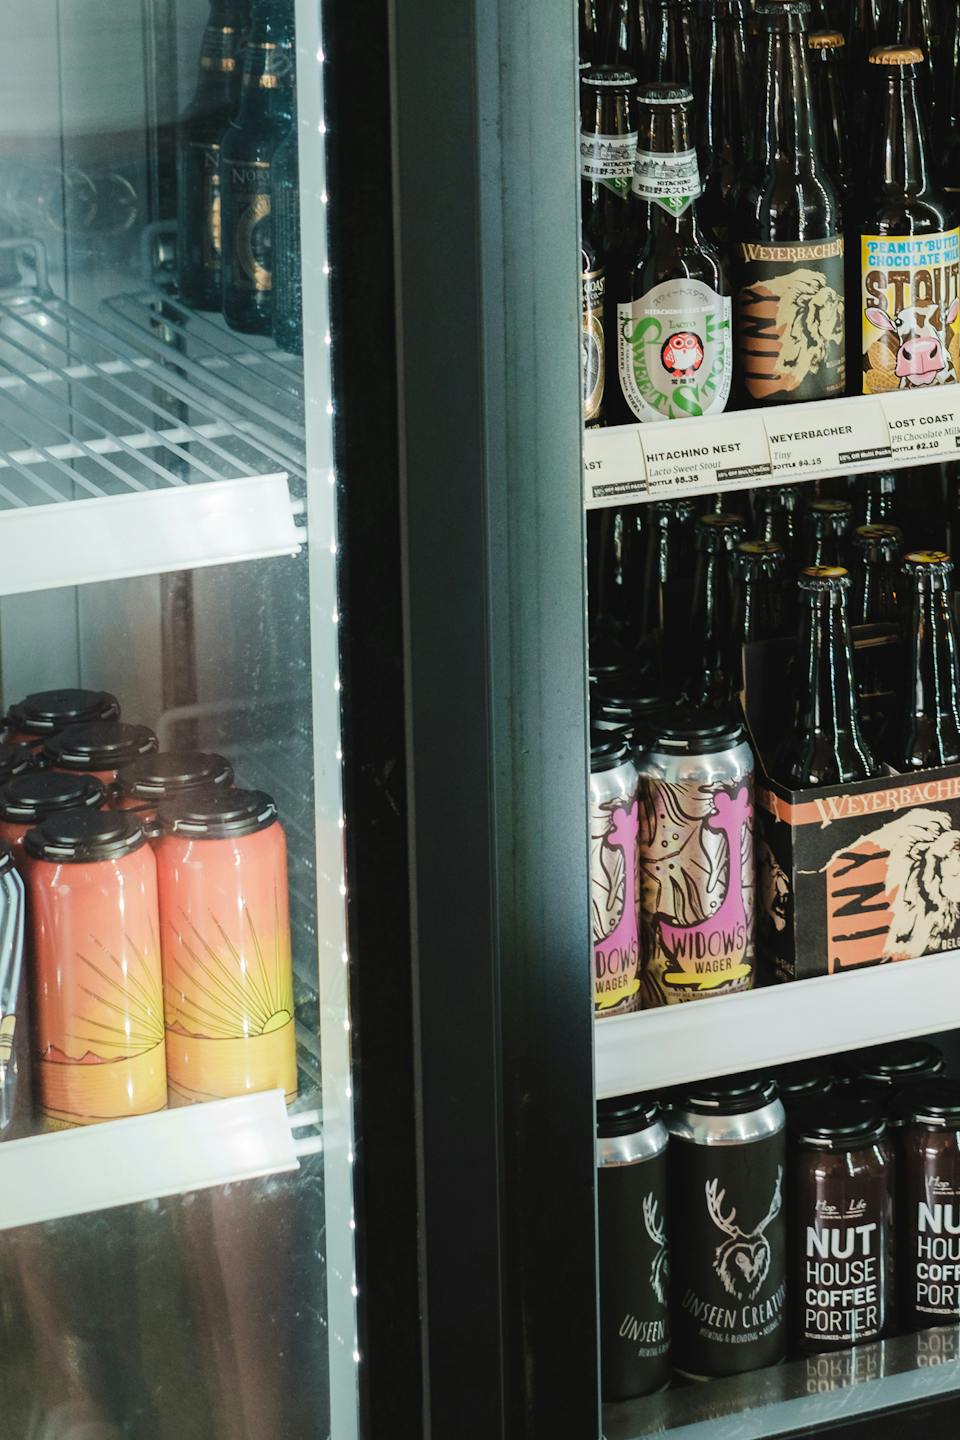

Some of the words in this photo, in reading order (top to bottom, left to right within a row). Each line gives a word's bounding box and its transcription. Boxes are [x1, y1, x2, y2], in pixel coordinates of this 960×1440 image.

[669, 196, 684, 208] SS
[741, 237, 844, 264] WEYERBACHER
[866, 240, 923, 255] PEANUT
[868, 251, 940, 267] CHOCOLATE
[865, 262, 960, 310] STOUT
[888, 418, 916, 430] LOST
[919, 413, 955, 426] COAST
[769, 425, 853, 444] WEYERBACHER
[891, 435, 902, 444] PB
[903, 429, 943, 443] Chocolate
[943, 426, 960, 437] Milk
[646, 447, 709, 462] HITACHINO
[713, 442, 742, 454] NEST
[773, 450, 792, 461] Tiny
[915, 441, 939, 451] $2.10
[649, 468, 672, 477] Lacto
[673, 464, 698, 474] Sweet
[699, 461, 722, 470] Stout
[671, 920, 746, 960] WIDOW'S
[694, 958, 732, 975] WAGER
[595, 973, 628, 994] WAGER
[806, 1223, 877, 1260] NUT
[806, 1257, 876, 1286] HOUSE
[806, 1284, 877, 1308] COFFEE
[682, 1287, 737, 1329] UNSEEN
[619, 1313, 665, 1343] UNSEEN
[805, 1305, 877, 1332] PORTER
